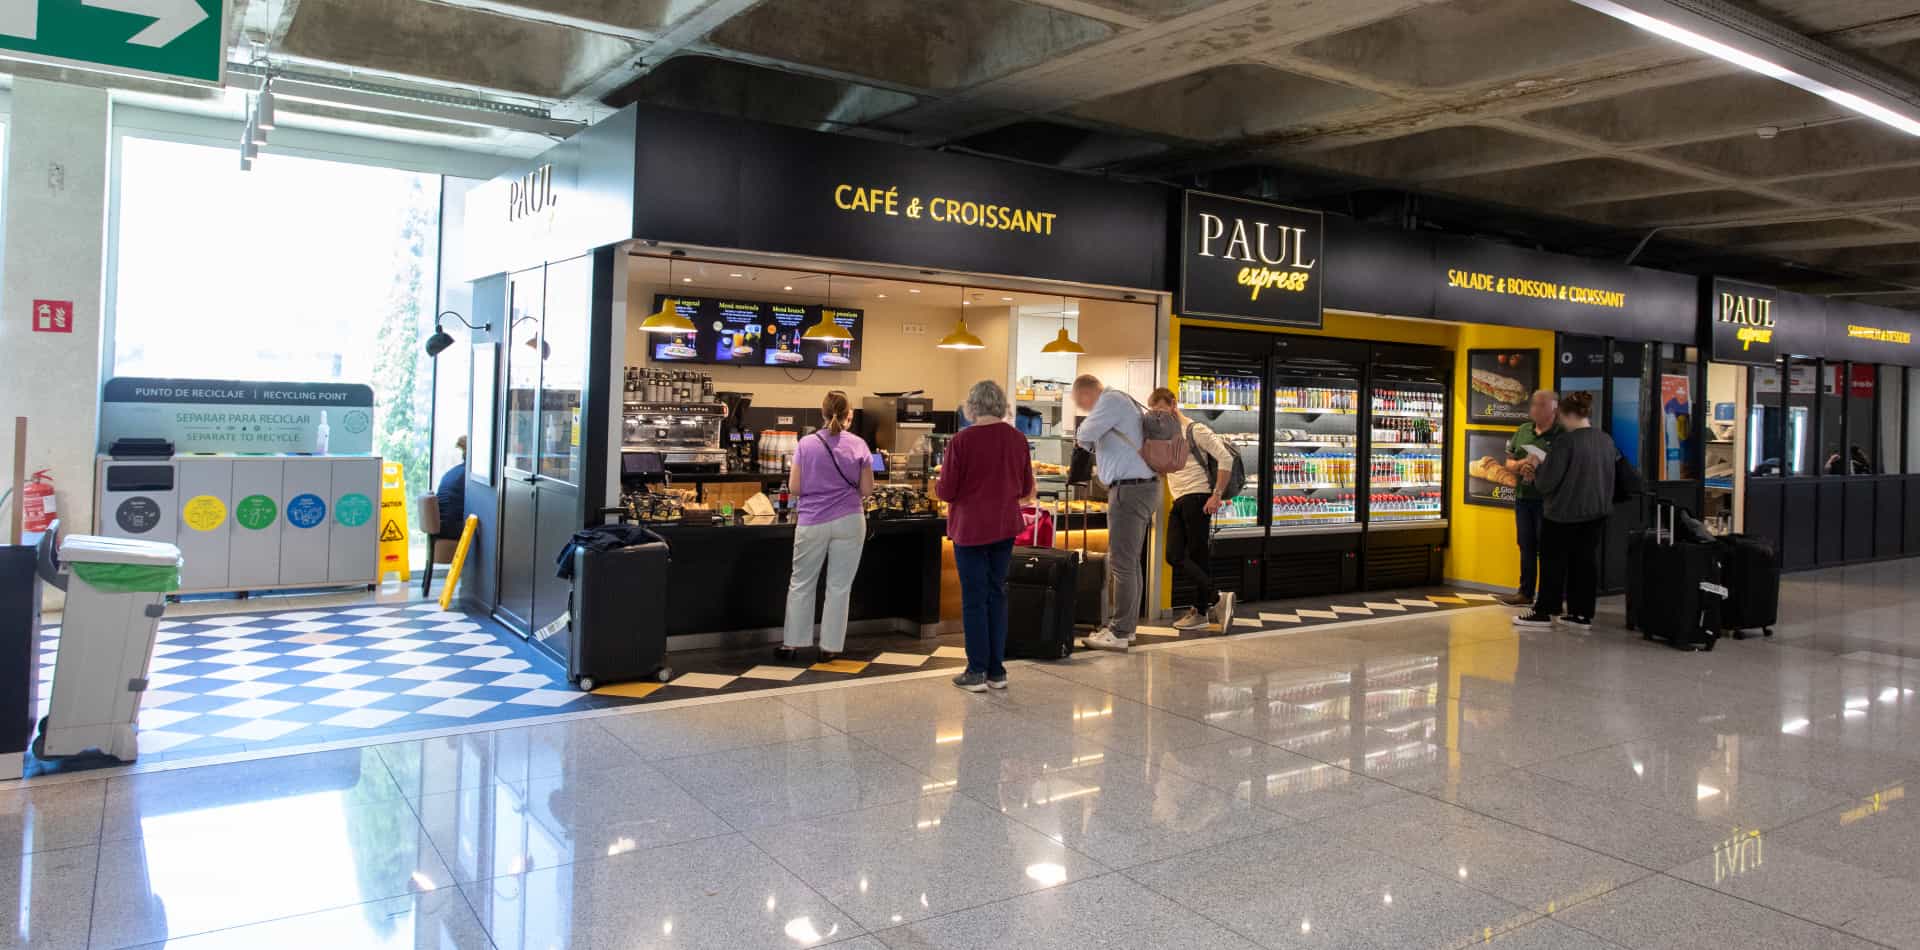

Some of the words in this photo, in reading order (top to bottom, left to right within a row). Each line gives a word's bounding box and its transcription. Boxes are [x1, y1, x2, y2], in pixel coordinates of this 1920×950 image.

[508, 164, 557, 222] PAUL
[834, 184, 899, 216] CAFÉ
[906, 197, 924, 219] &
[929, 197, 1057, 235] CROISSANT
[1197, 212, 1316, 269] PAUL
[1237, 266, 1309, 301] express
[1447, 269, 1494, 292] SALADE
[1496, 278, 1506, 293] &
[1507, 277, 1557, 300] BOISSON
[1559, 285, 1568, 300] &
[1568, 286, 1626, 309] CROISSANT
[1720, 292, 1776, 328] PAUL
[135, 387, 173, 398] PUNTO
[174, 388, 191, 398] DE
[192, 389, 245, 399] RECICLAJE
[263, 390, 316, 401] RECYCLING
[318, 391, 349, 401] POINT
[176, 412, 226, 424] SEPARAR
[227, 413, 257, 424] PARA
[259, 414, 311, 425] RECICLAR
[186, 432, 238, 442] SEPARATE
[240, 433, 252, 442] TO
[254, 433, 300, 443] RECYCLE
